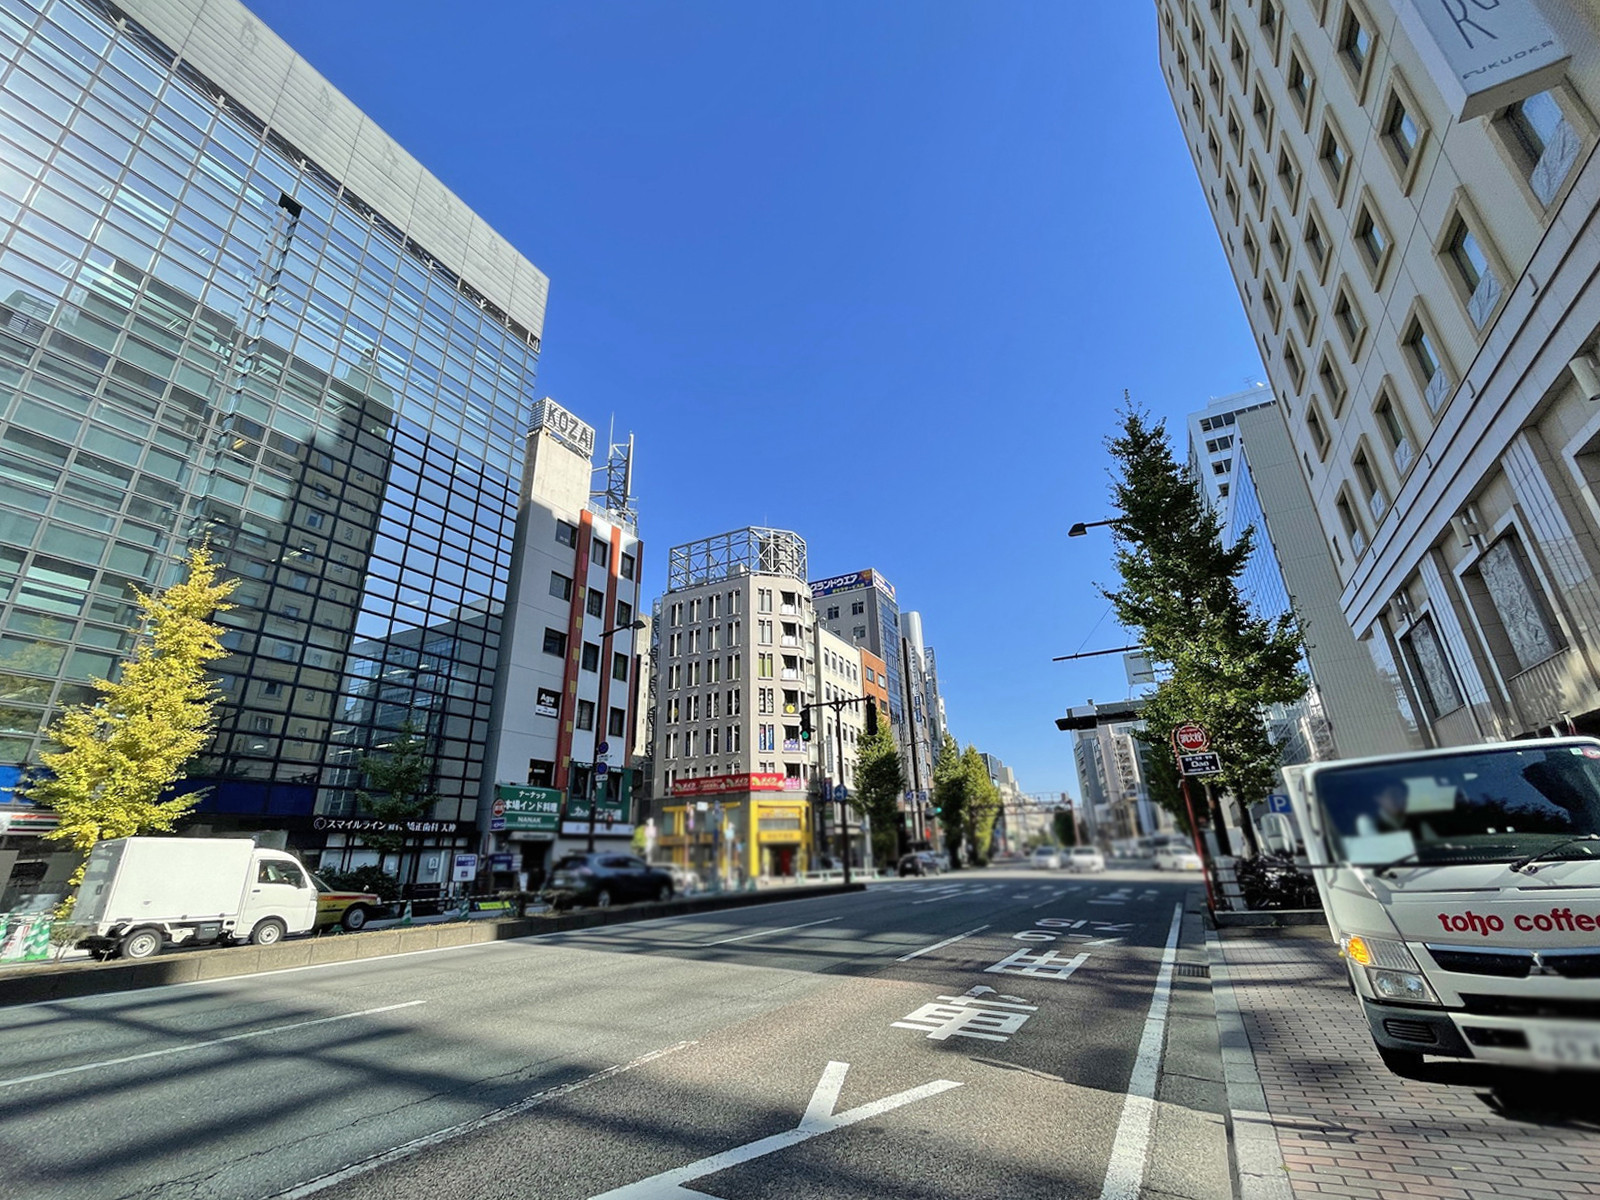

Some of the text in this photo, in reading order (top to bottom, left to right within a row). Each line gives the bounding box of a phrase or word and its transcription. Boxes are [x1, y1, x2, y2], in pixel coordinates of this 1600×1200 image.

[1273, 796, 1287, 811] P
[326, 819, 386, 830] スマイルライン
[1437, 908, 1600, 936] toho coffe
